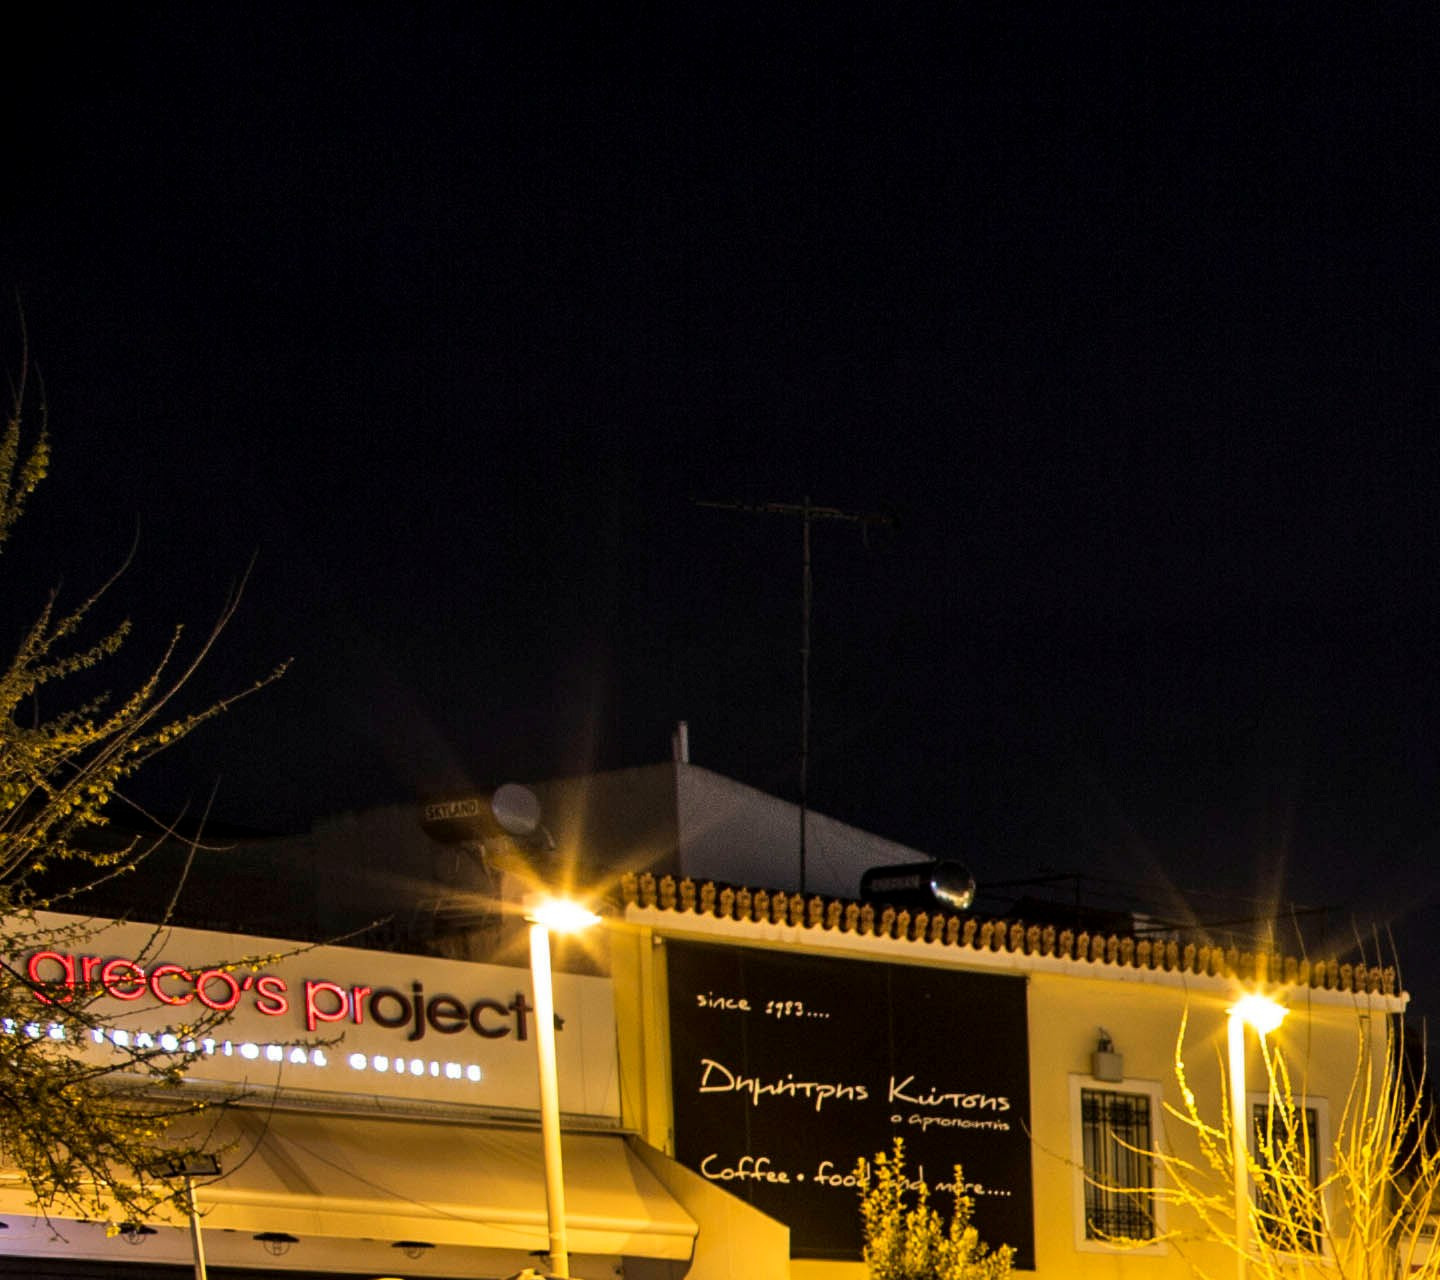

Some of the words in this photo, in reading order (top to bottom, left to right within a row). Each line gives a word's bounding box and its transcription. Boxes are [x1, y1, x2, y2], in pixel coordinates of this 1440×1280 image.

[28, 951, 289, 1016] greco's
[305, 979, 534, 1042] project
[696, 991, 751, 1012] since
[701, 1153, 791, 1185] Coffee
